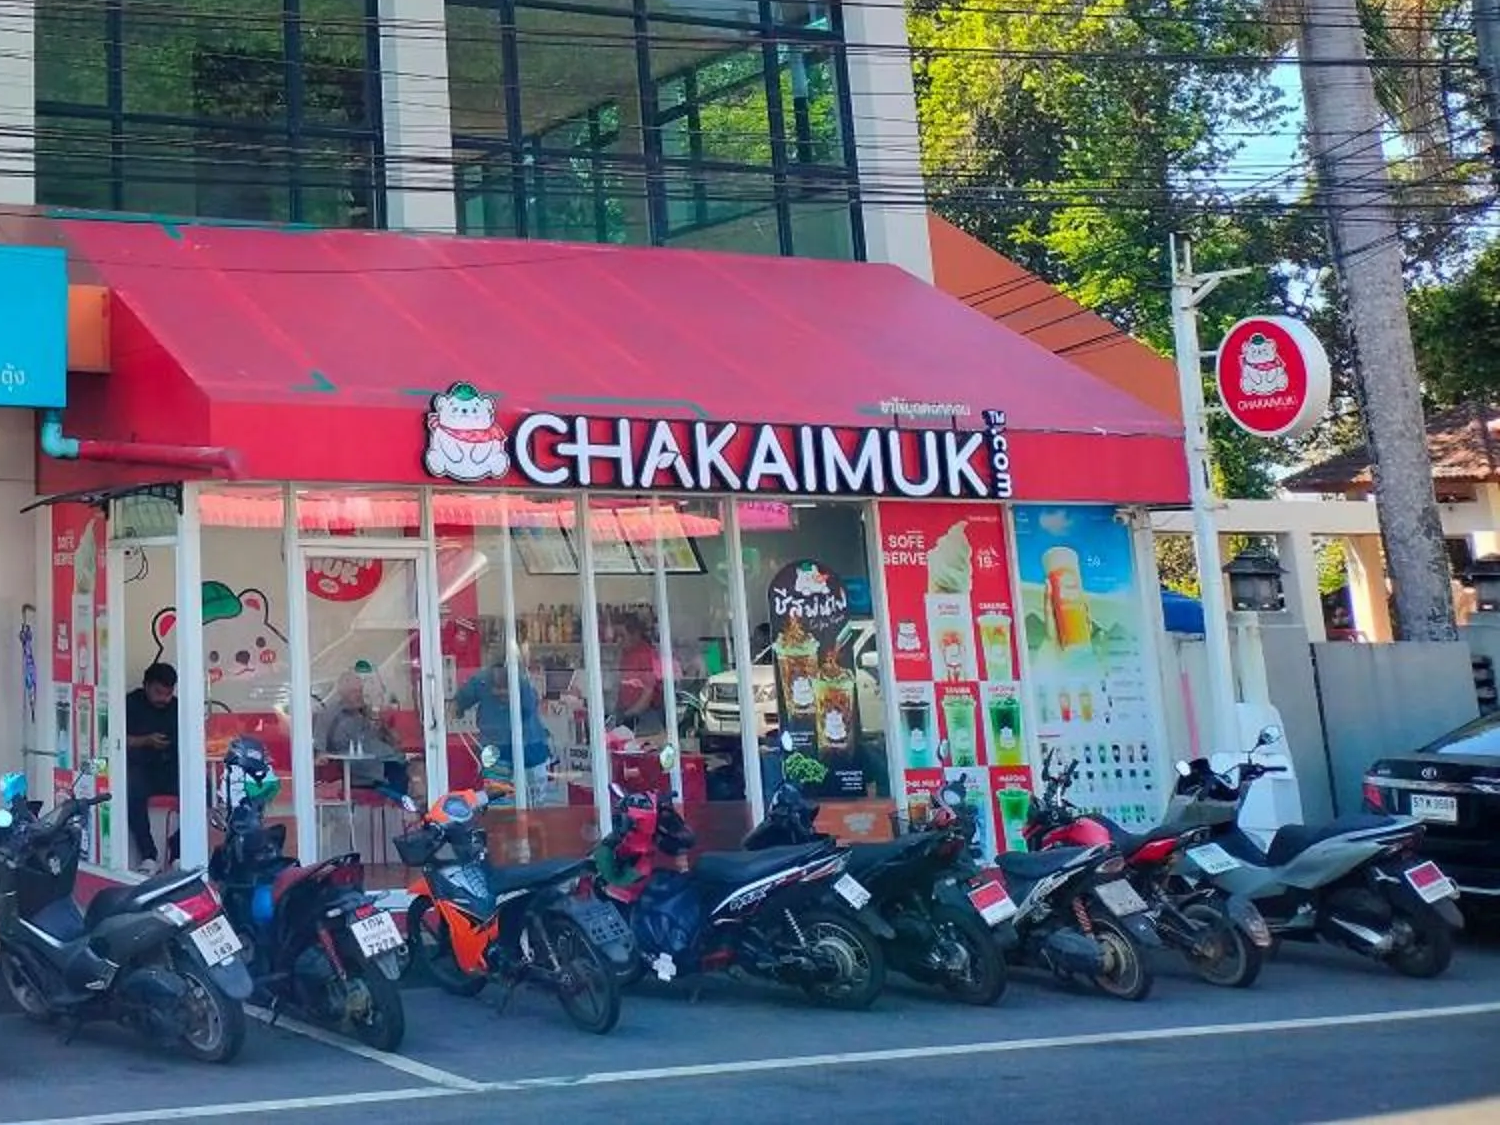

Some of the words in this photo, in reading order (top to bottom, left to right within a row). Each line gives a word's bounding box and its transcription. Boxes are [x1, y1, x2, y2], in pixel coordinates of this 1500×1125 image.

[515, 413, 988, 497] CHAKAIMUK
[990, 428, 1013, 498] .com
[883, 551, 928, 566] SERVE
